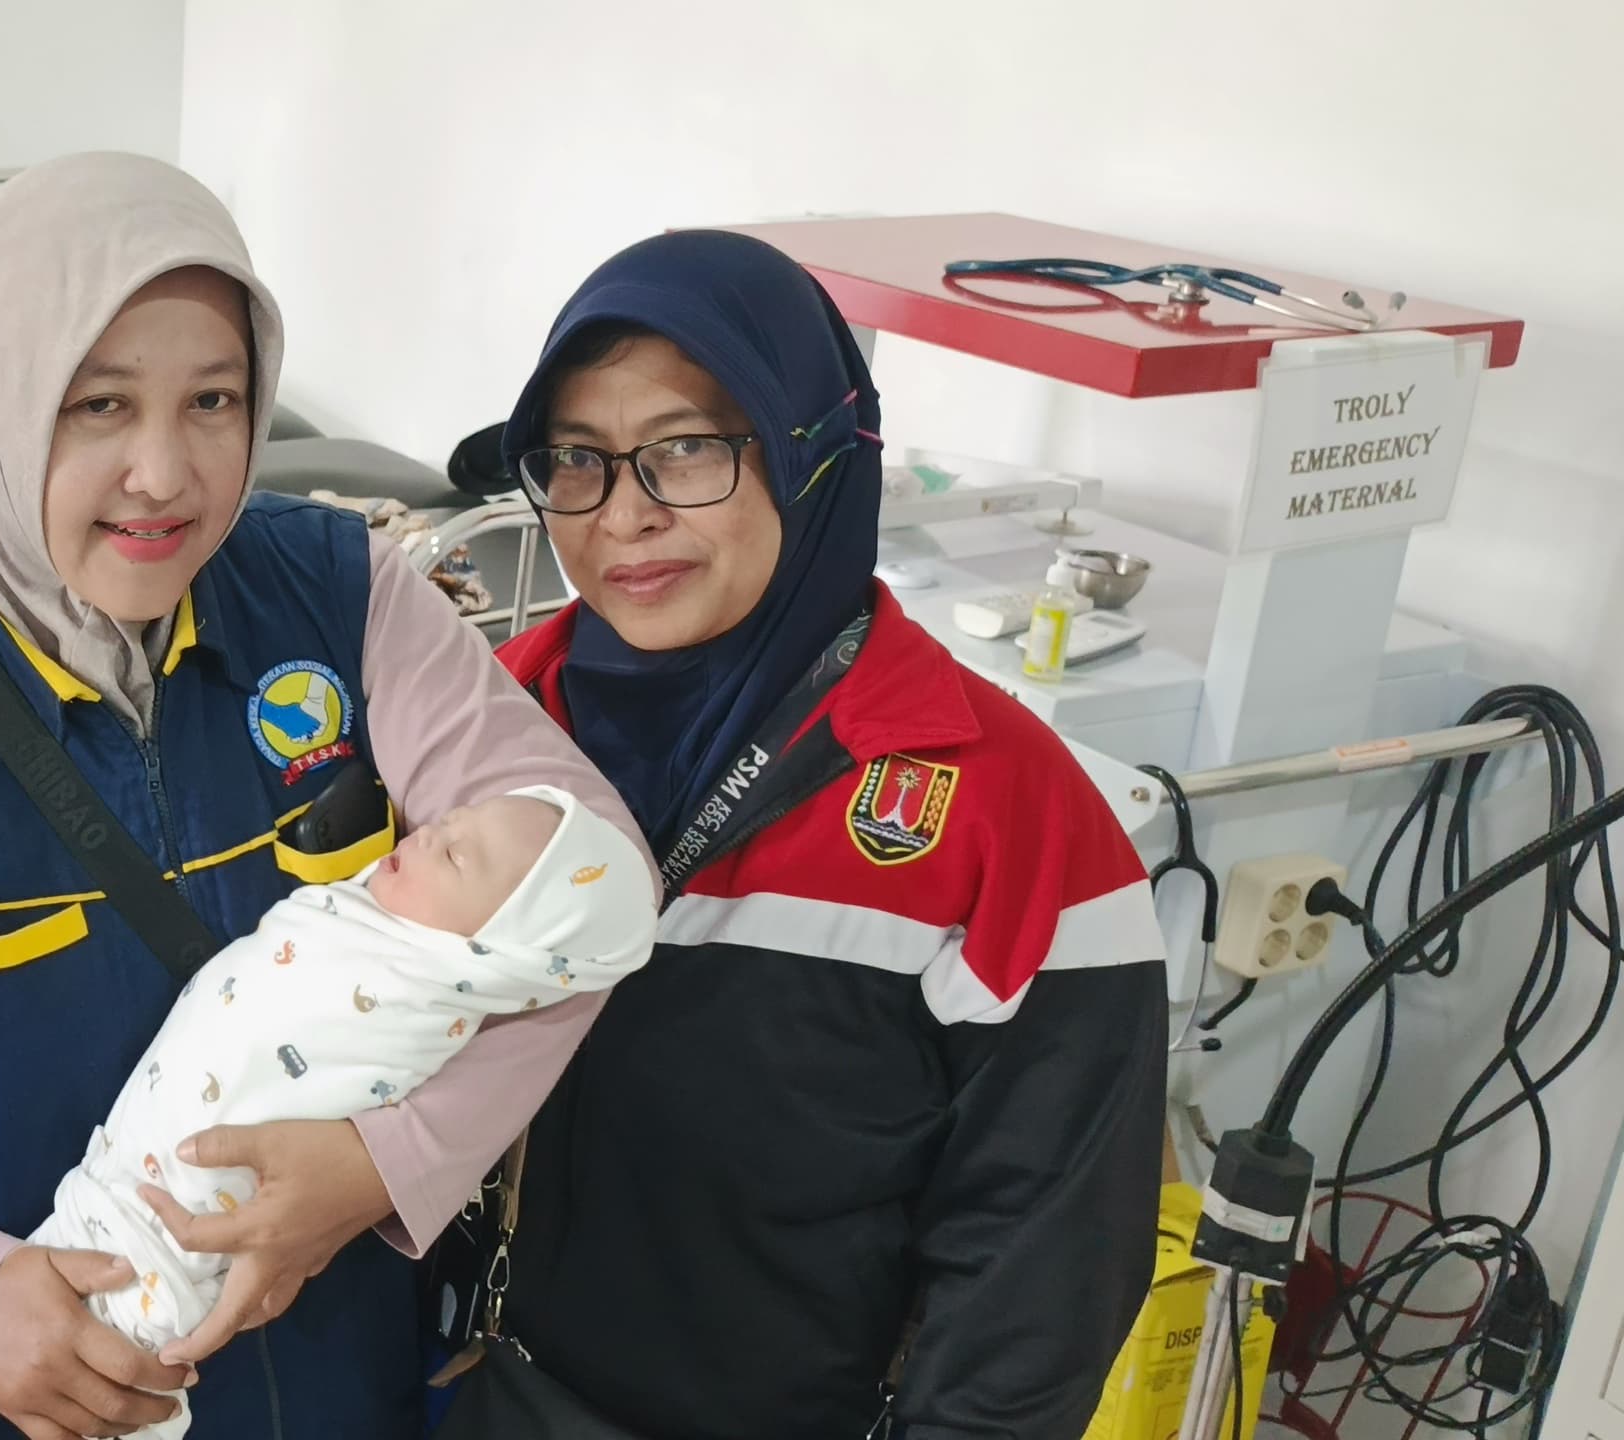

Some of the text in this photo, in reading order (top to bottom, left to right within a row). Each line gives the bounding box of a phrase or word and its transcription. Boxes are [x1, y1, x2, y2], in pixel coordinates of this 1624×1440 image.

[1334, 384, 1415, 423] TROLY
[1289, 426, 1441, 475] EMERGENCY
[1285, 478, 1417, 520] MATERNAL
[294, 744, 342, 771] TKSK
[721, 743, 769, 800] PSM
[661, 794, 723, 875] KOTA SEMARA
[663, 802, 732, 889] KEC. NGALIYA
